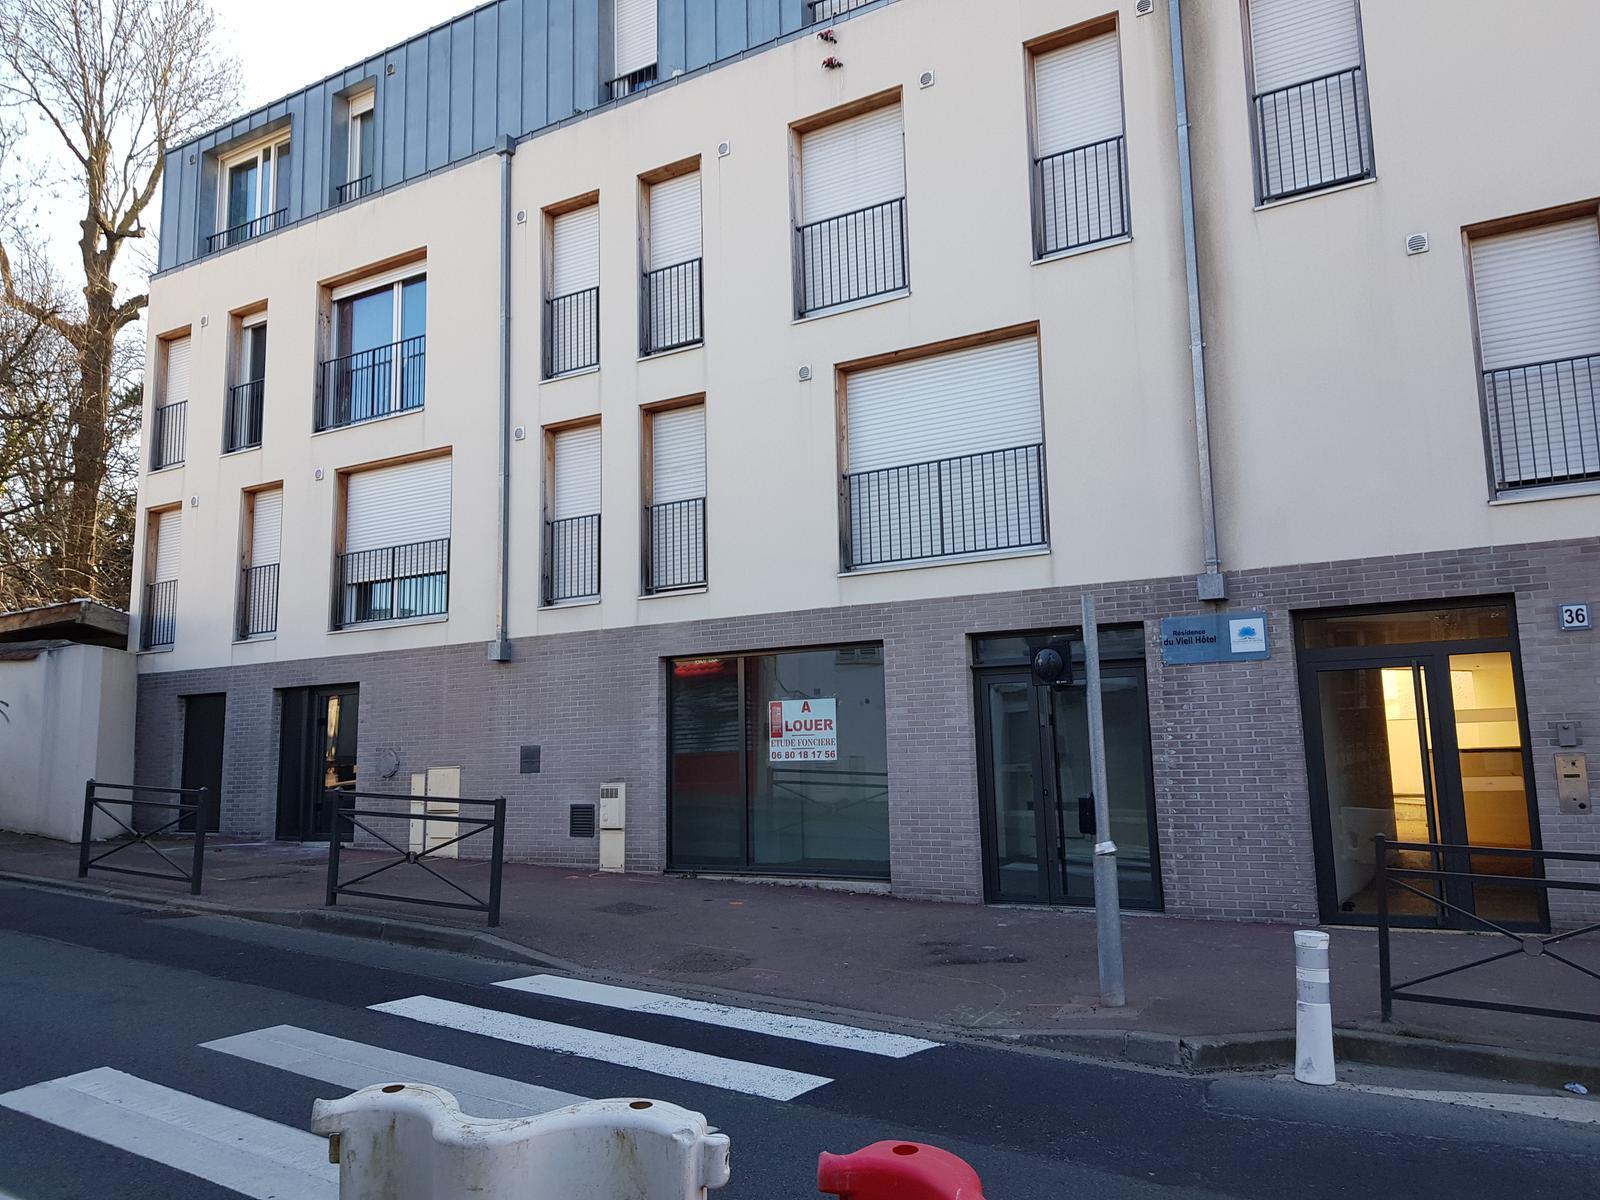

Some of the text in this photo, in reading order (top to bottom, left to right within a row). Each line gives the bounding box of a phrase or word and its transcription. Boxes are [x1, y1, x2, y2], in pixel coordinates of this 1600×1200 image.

[1564, 608, 1585, 624] 36
[1163, 635, 1217, 646] du Vieil Hôtel
[801, 701, 811, 713] A
[785, 719, 833, 732] LOUER
[771, 738, 836, 747] ETUDE FONCIERE
[771, 750, 836, 759] 06 80 18 17 56
